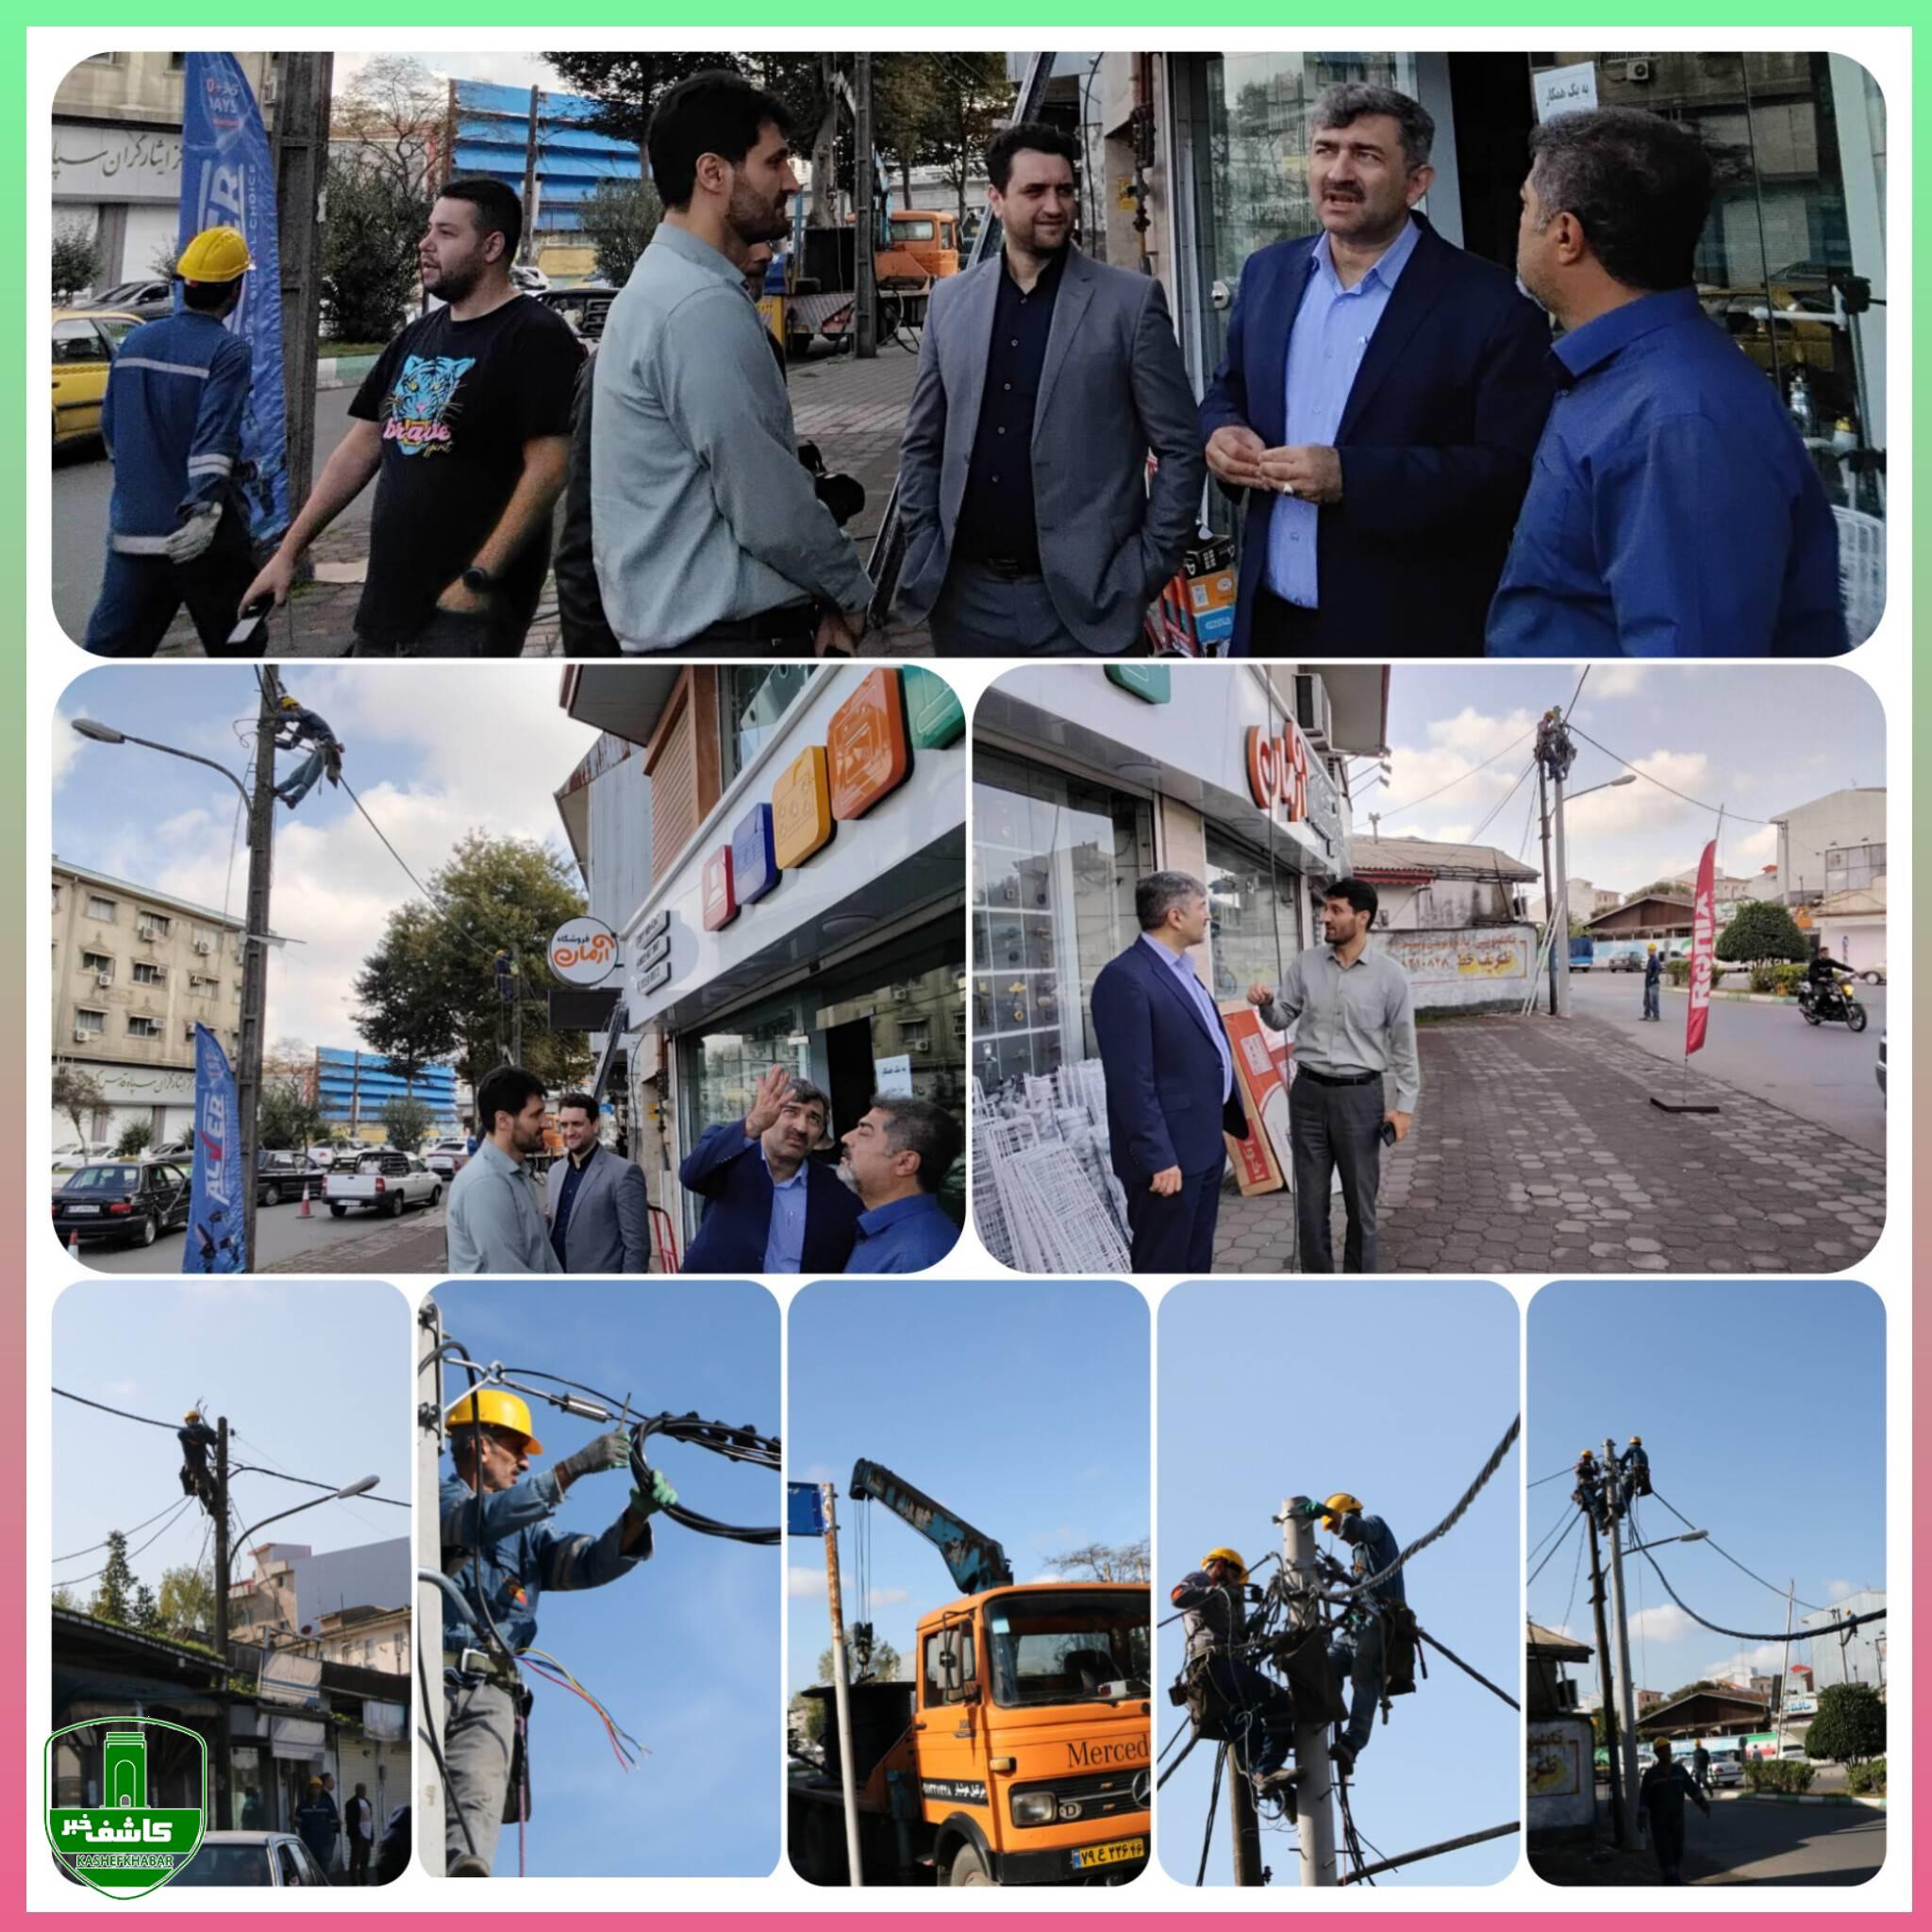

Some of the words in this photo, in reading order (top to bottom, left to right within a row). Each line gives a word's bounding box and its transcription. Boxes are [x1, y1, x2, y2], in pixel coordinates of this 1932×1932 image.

[247, 164, 258, 230] CHOICE
[383, 417, 452, 441] brave
[553, 933, 616, 968] آرمان
[557, 933, 591, 944] فروشگاه
[1066, 1734, 1151, 1769] Merced
[1065, 1804, 1077, 1816] D
